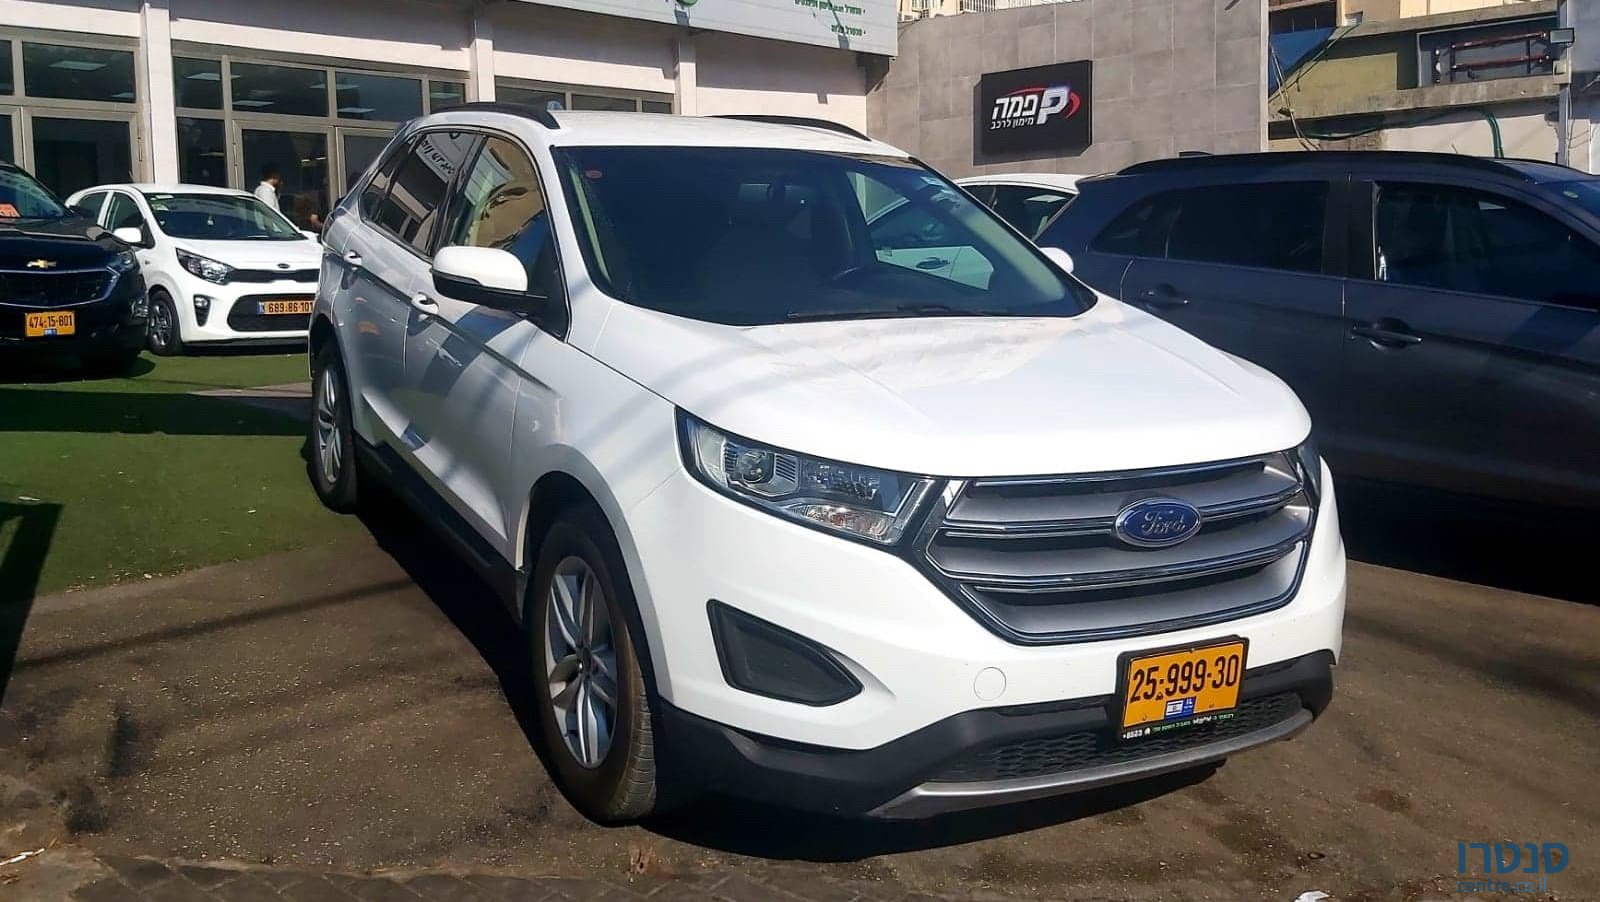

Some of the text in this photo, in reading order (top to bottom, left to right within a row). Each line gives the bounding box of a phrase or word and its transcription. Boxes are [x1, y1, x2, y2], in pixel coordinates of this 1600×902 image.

[991, 94, 1038, 120] פמה
[990, 117, 1034, 130] מימון לרכב
[1141, 511, 1186, 536] Ford
[1130, 654, 1240, 703] 25-999-30
